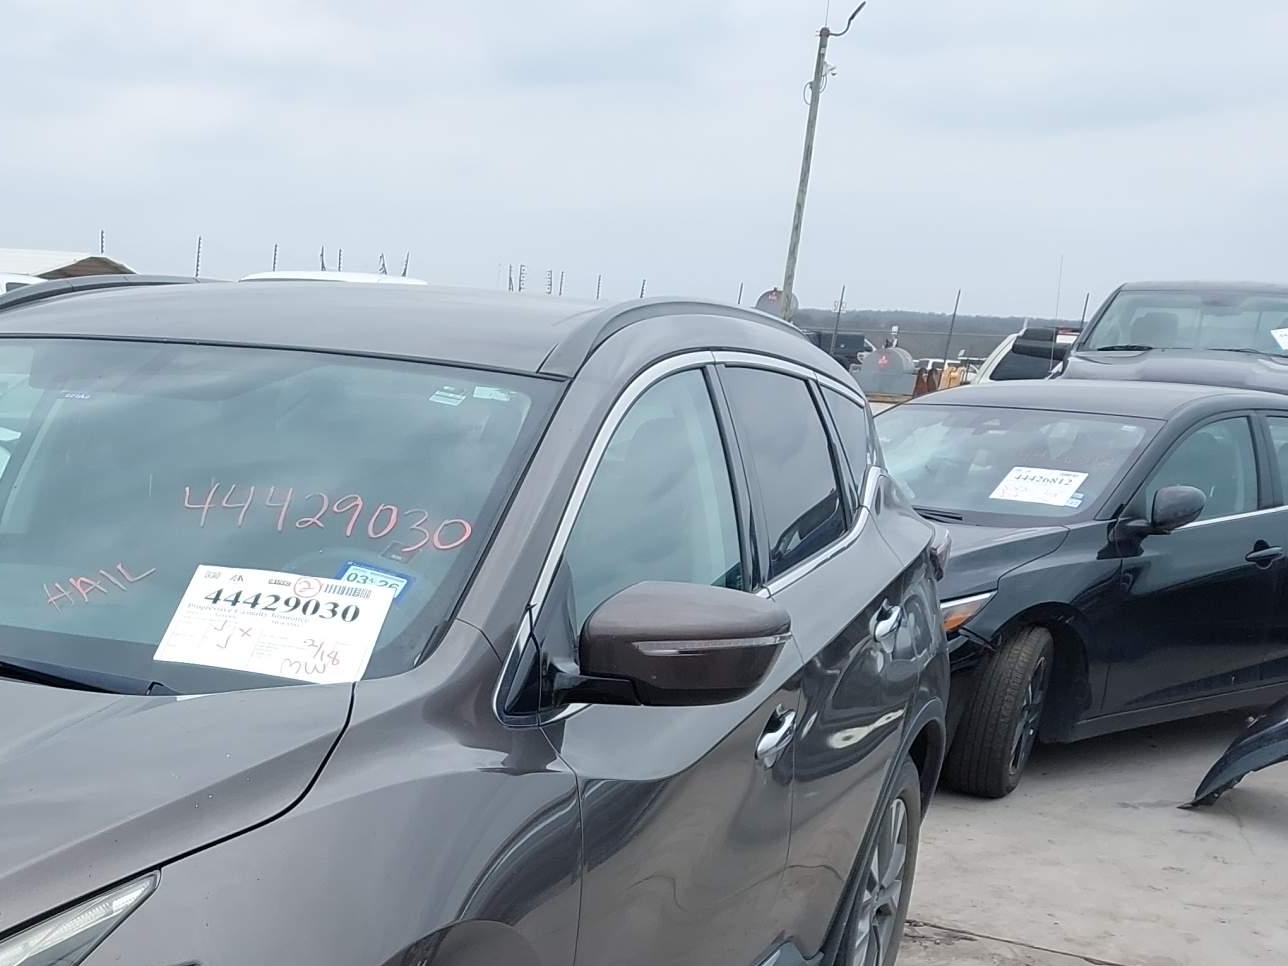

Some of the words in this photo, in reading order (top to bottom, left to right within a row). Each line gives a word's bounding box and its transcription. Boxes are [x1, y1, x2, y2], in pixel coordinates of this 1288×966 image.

[184, 480, 472, 553] 44429030
[42, 562, 157, 613] HAIL
[346, 572, 369, 585] 03
[204, 587, 361, 623] 44429030
[303, 638, 340, 666] 2/18
